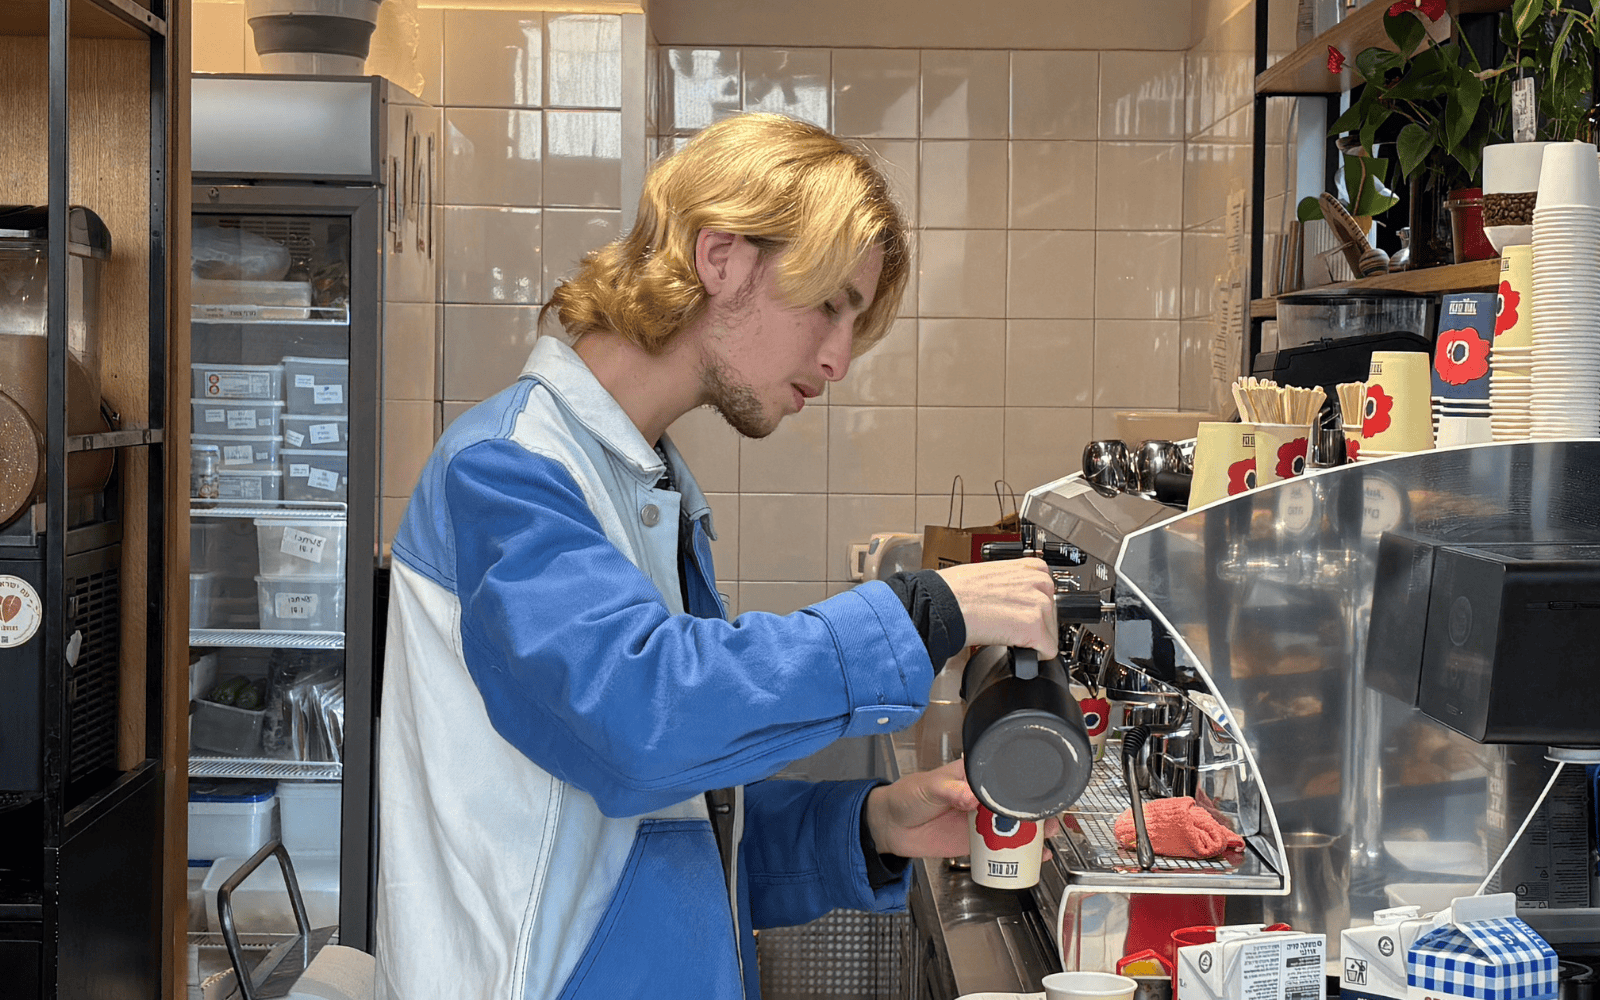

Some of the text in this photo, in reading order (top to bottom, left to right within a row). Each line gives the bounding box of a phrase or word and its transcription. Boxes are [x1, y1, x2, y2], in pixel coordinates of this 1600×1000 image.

[0, 581, 30, 598] עם ישרא
[1300, 941, 1317, 949] משקה
[1513, 920, 1553, 953] מהדרין
